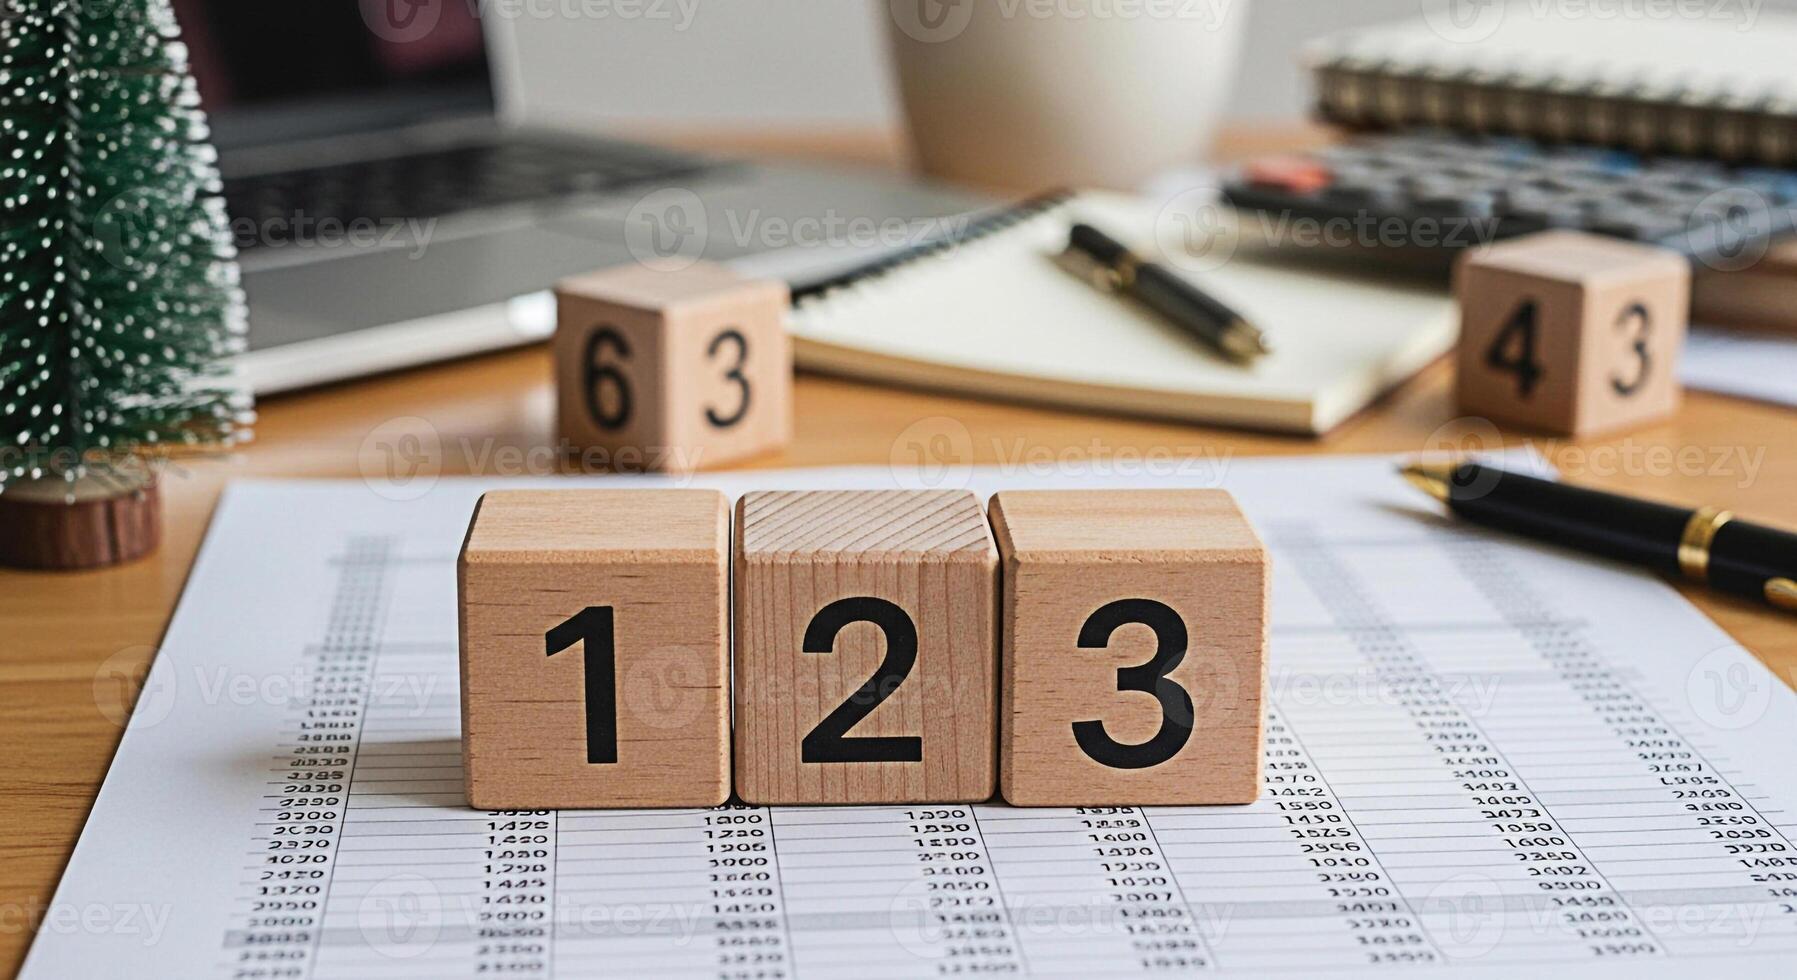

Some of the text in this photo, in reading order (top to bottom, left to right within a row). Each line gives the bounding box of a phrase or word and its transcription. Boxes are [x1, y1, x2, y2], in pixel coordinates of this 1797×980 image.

[582, 325, 752, 431] 6 3
[1487, 297, 1651, 398] 4 3
[545, 606, 618, 764] 1
[801, 596, 922, 764] 2
[1071, 598, 1195, 770] 3
